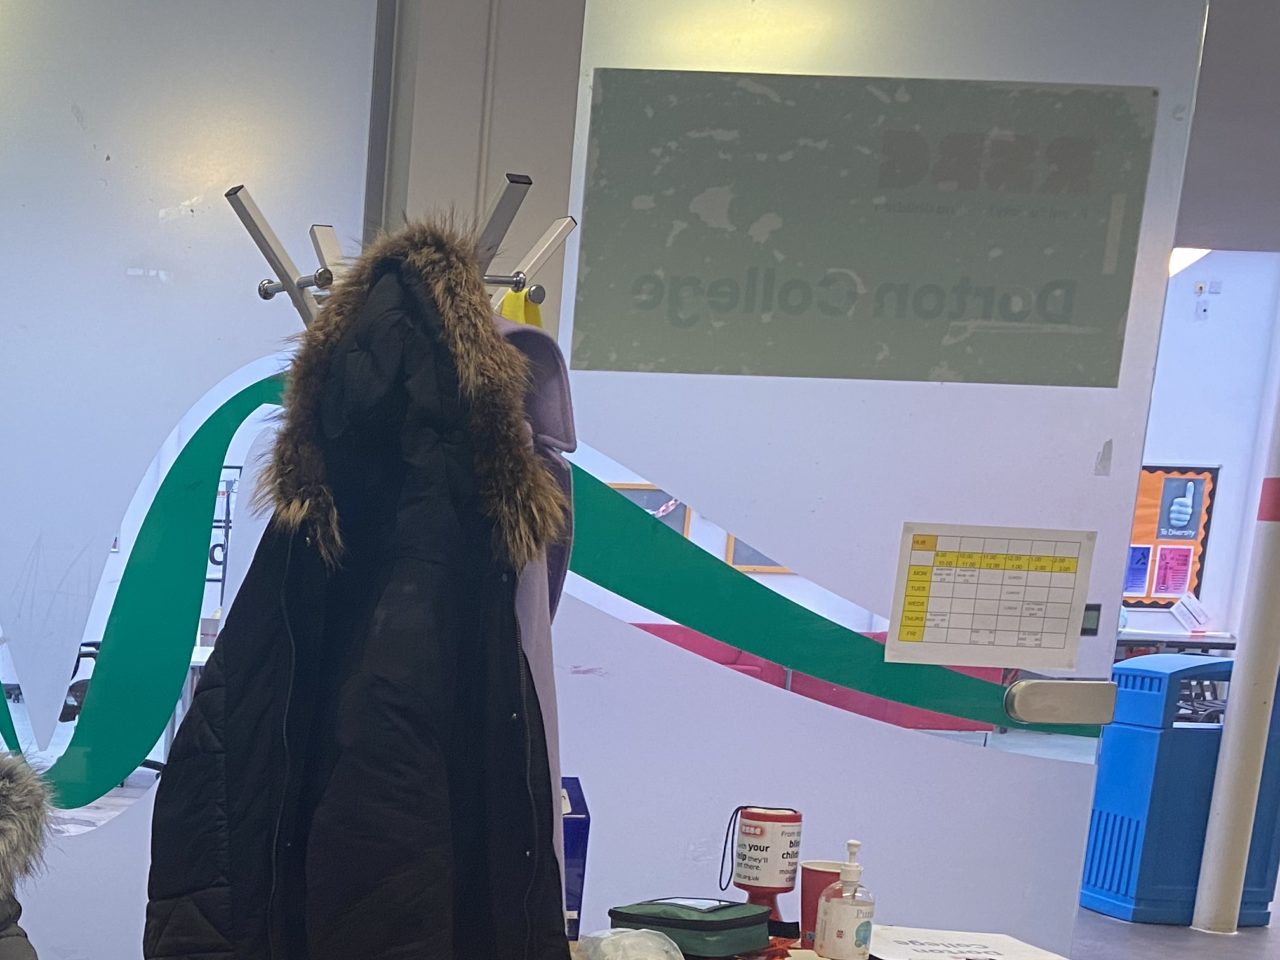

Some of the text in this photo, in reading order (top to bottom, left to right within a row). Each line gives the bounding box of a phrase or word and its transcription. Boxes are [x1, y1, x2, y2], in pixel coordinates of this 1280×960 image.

[1160, 528, 1197, 539] To Diversity
[894, 940, 989, 949] College
[912, 948, 1004, 956] Dorton
